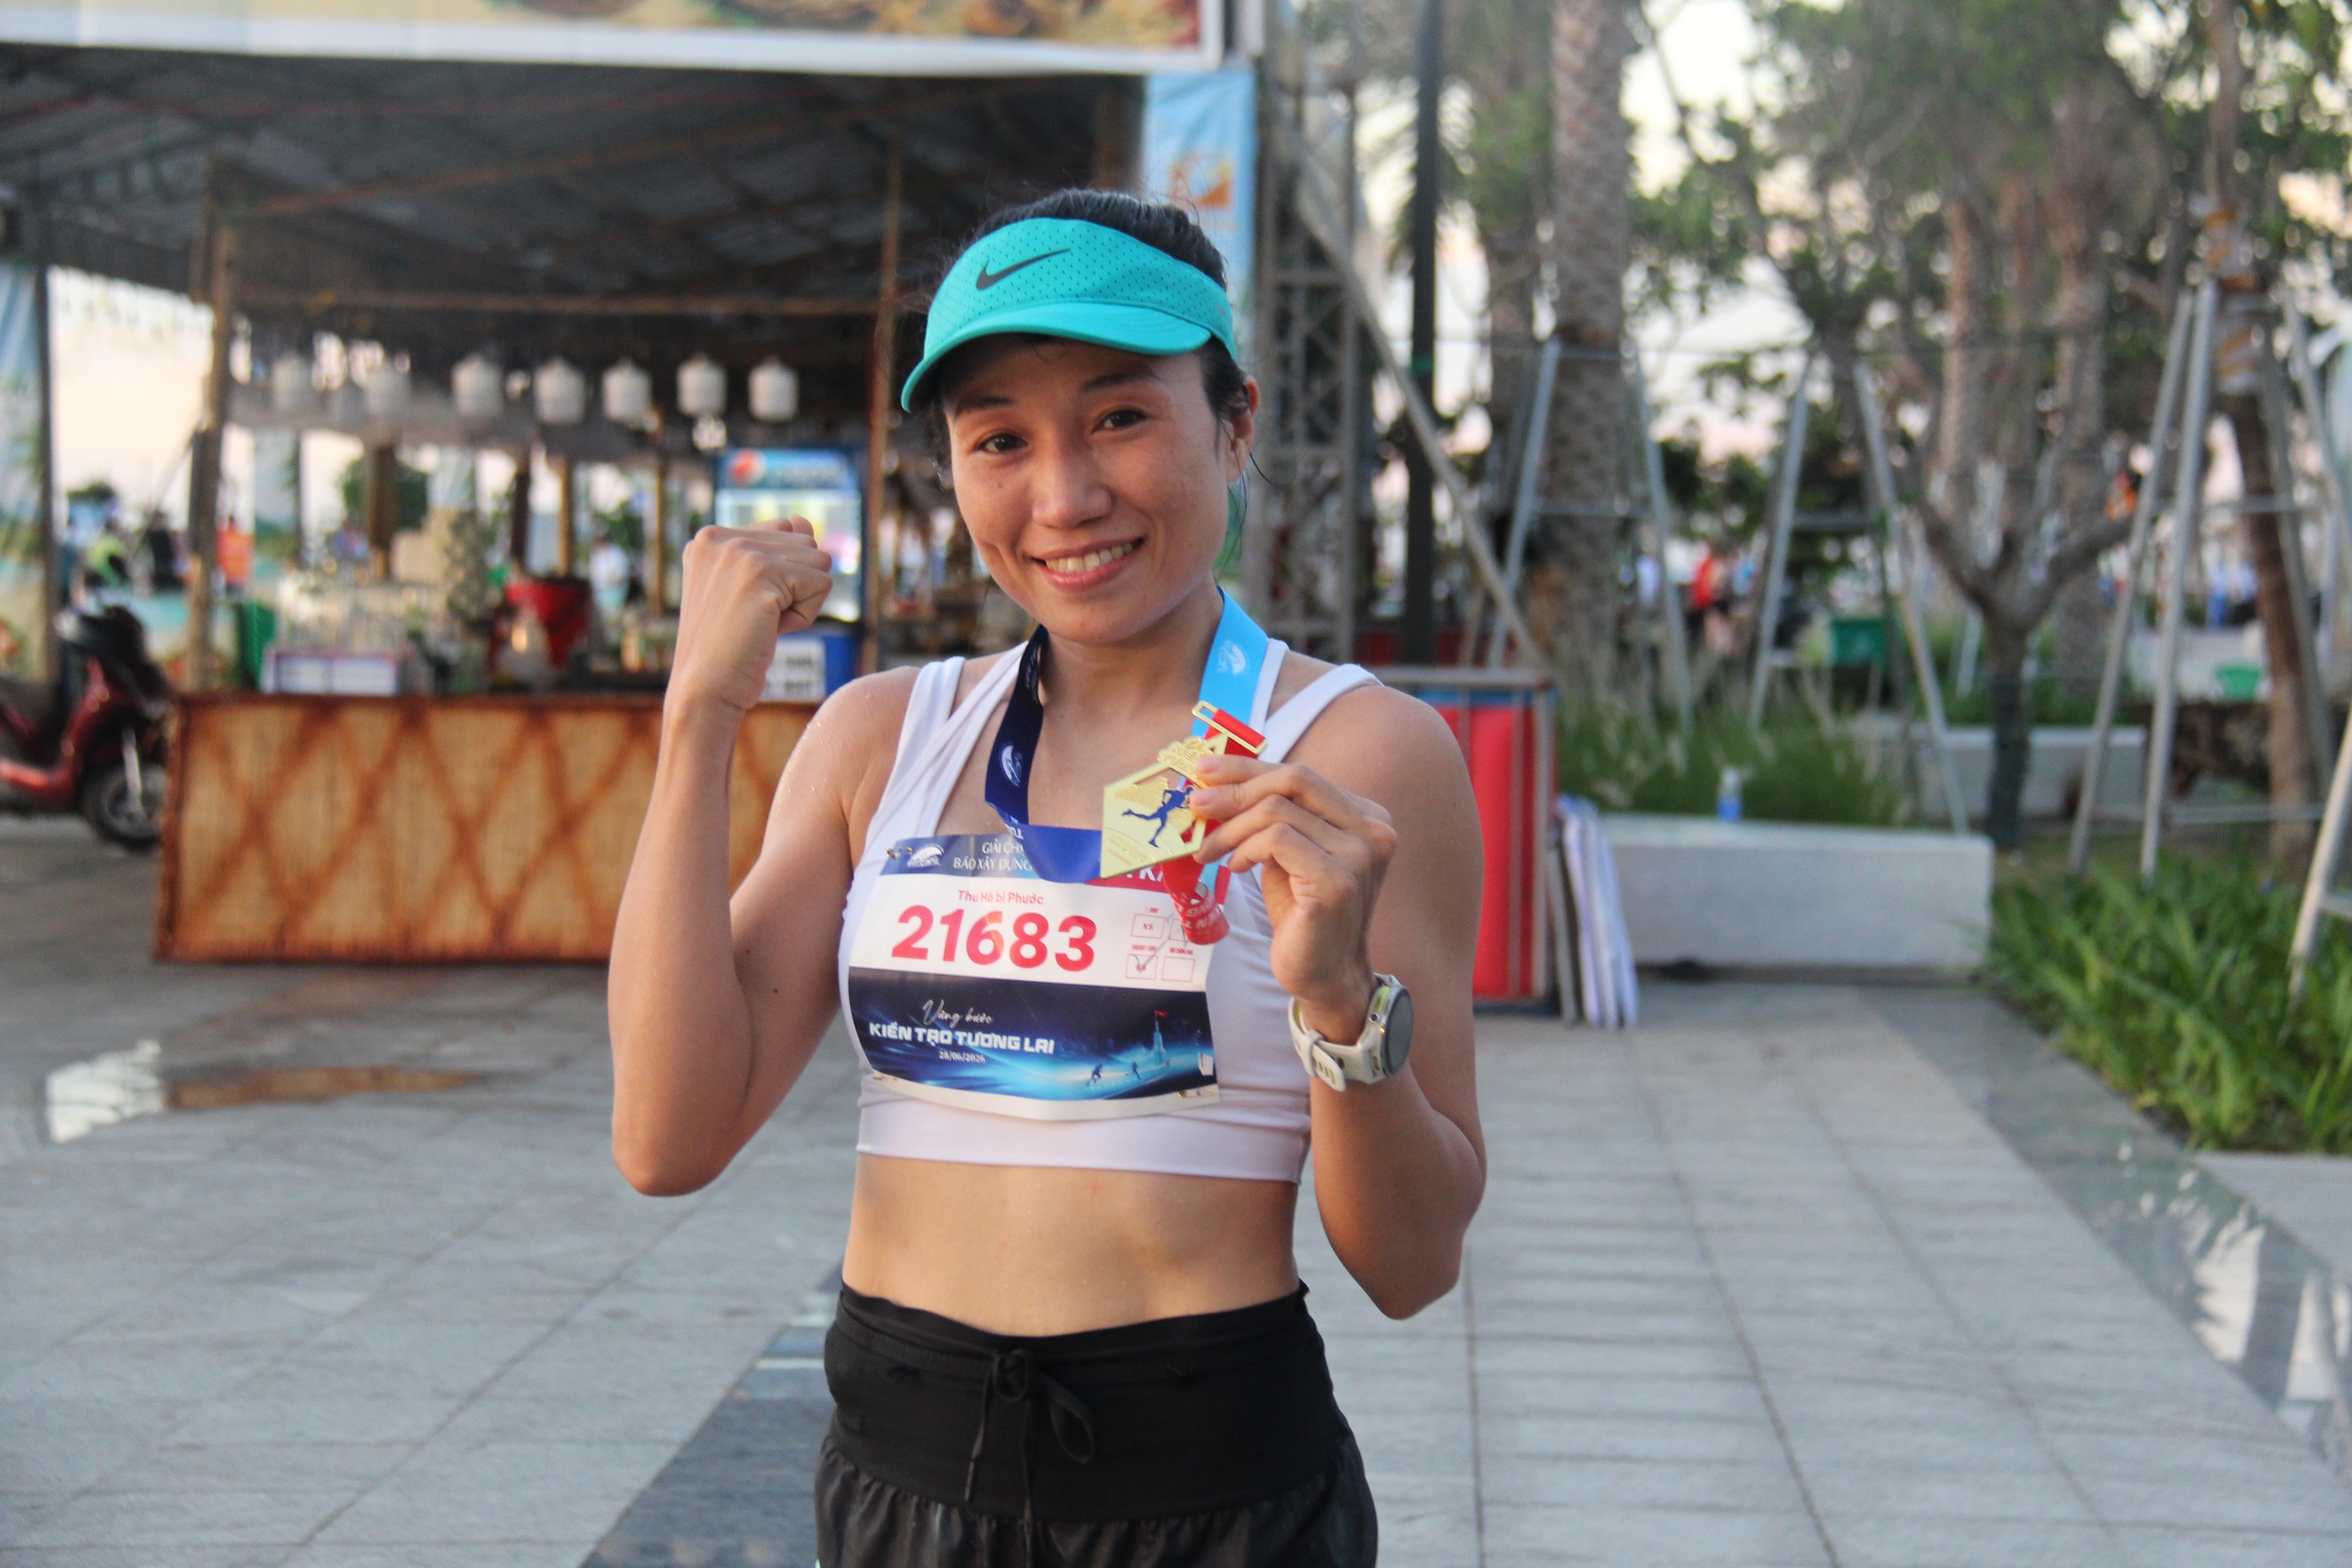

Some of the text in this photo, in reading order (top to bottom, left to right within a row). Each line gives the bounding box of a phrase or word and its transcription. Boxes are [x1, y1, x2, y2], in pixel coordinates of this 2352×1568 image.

[982, 838, 1001, 854] GIẢI
[953, 855, 977, 871] BÁO
[977, 855, 995, 871] XÂY
[957, 889, 978, 902] Thu
[1142, 922, 1154, 931] XS
[891, 904, 1098, 972] 21683
[869, 1021, 1056, 1055] KIẾN TẠO TƯƠNG LAI
